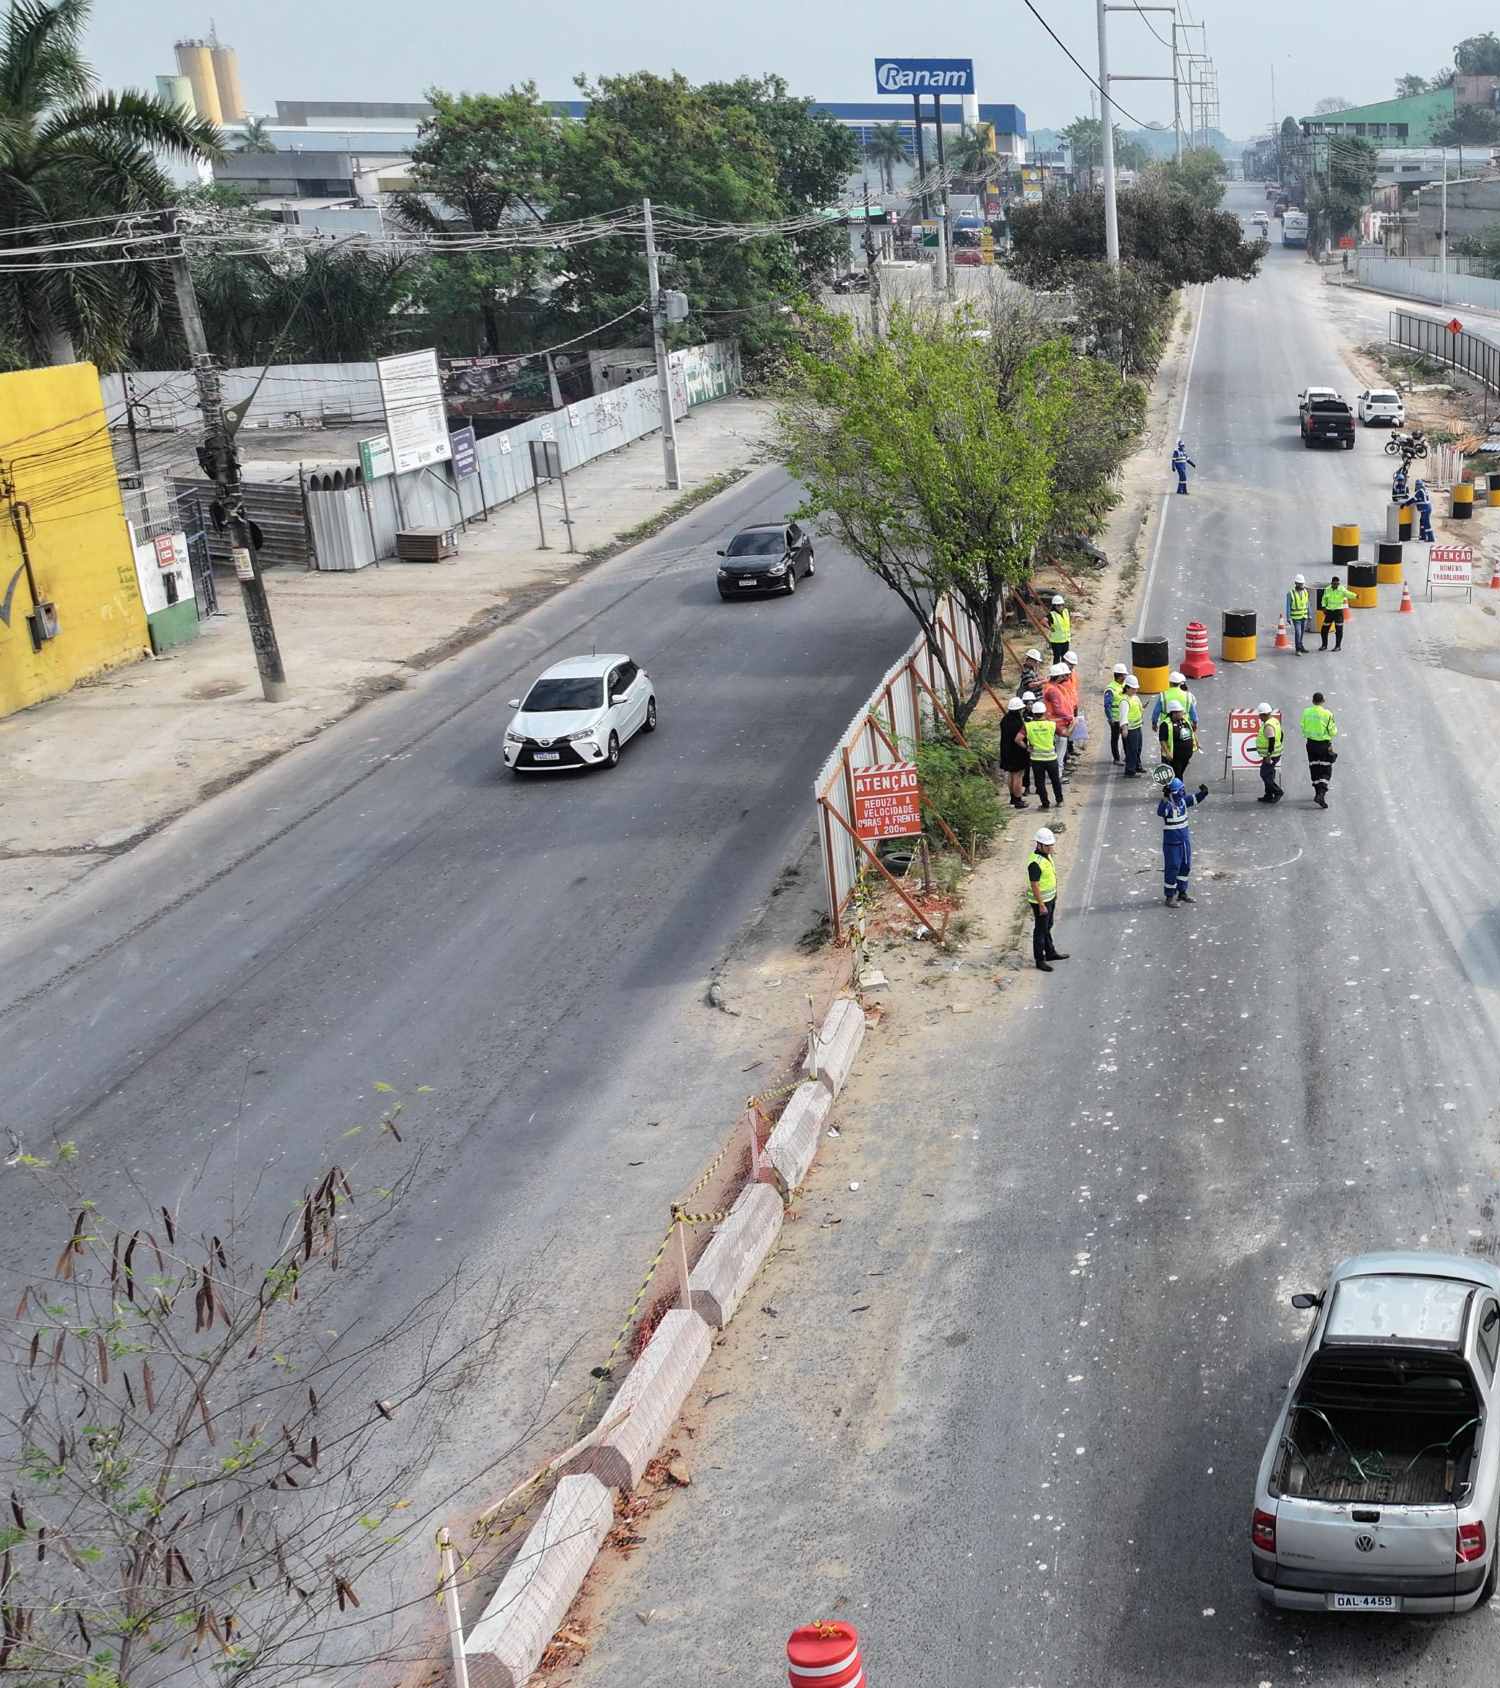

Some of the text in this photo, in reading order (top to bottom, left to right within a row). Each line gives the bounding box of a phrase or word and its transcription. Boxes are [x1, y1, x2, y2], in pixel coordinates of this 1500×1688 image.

[879, 63, 967, 90] Ranam
[856, 772, 917, 792] ATENÇÃO
[864, 797, 897, 809] REDUZA
[864, 804, 914, 818] VELOCIDADE
[893, 812, 921, 825] FRENTE
[883, 824, 907, 835] 200m
